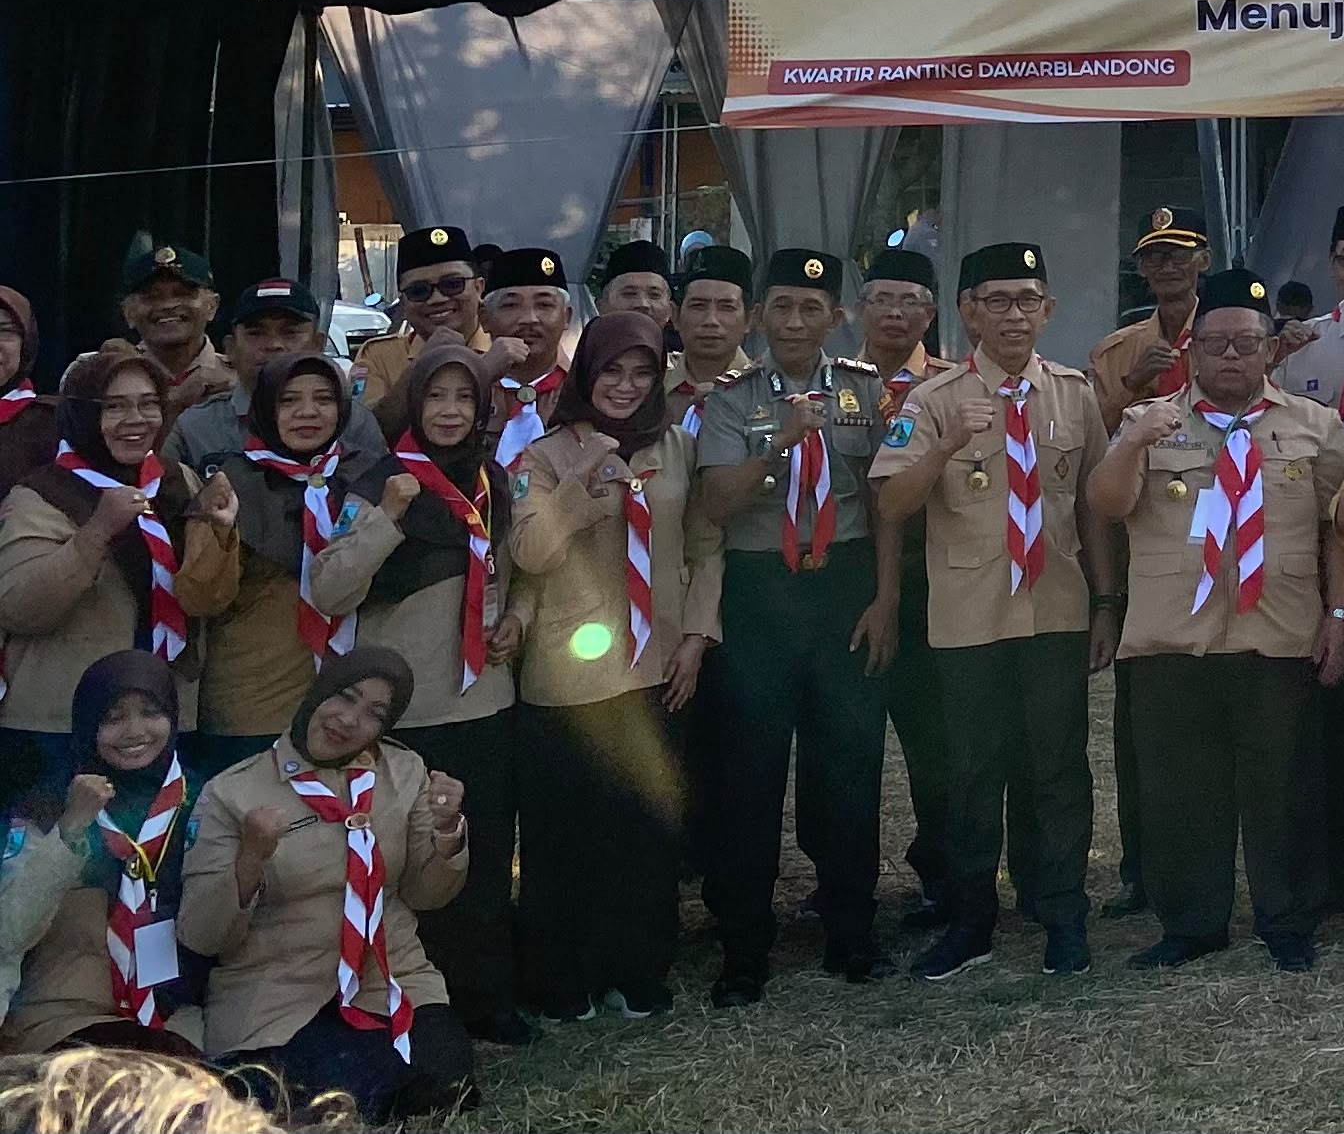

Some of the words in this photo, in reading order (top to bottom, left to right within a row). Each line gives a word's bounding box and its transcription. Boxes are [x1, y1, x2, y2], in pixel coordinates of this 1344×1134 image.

[783, 67, 874, 85] KWARTIR
[878, 63, 974, 82] RANTING
[978, 57, 1175, 79] DAWARBLANDONG
